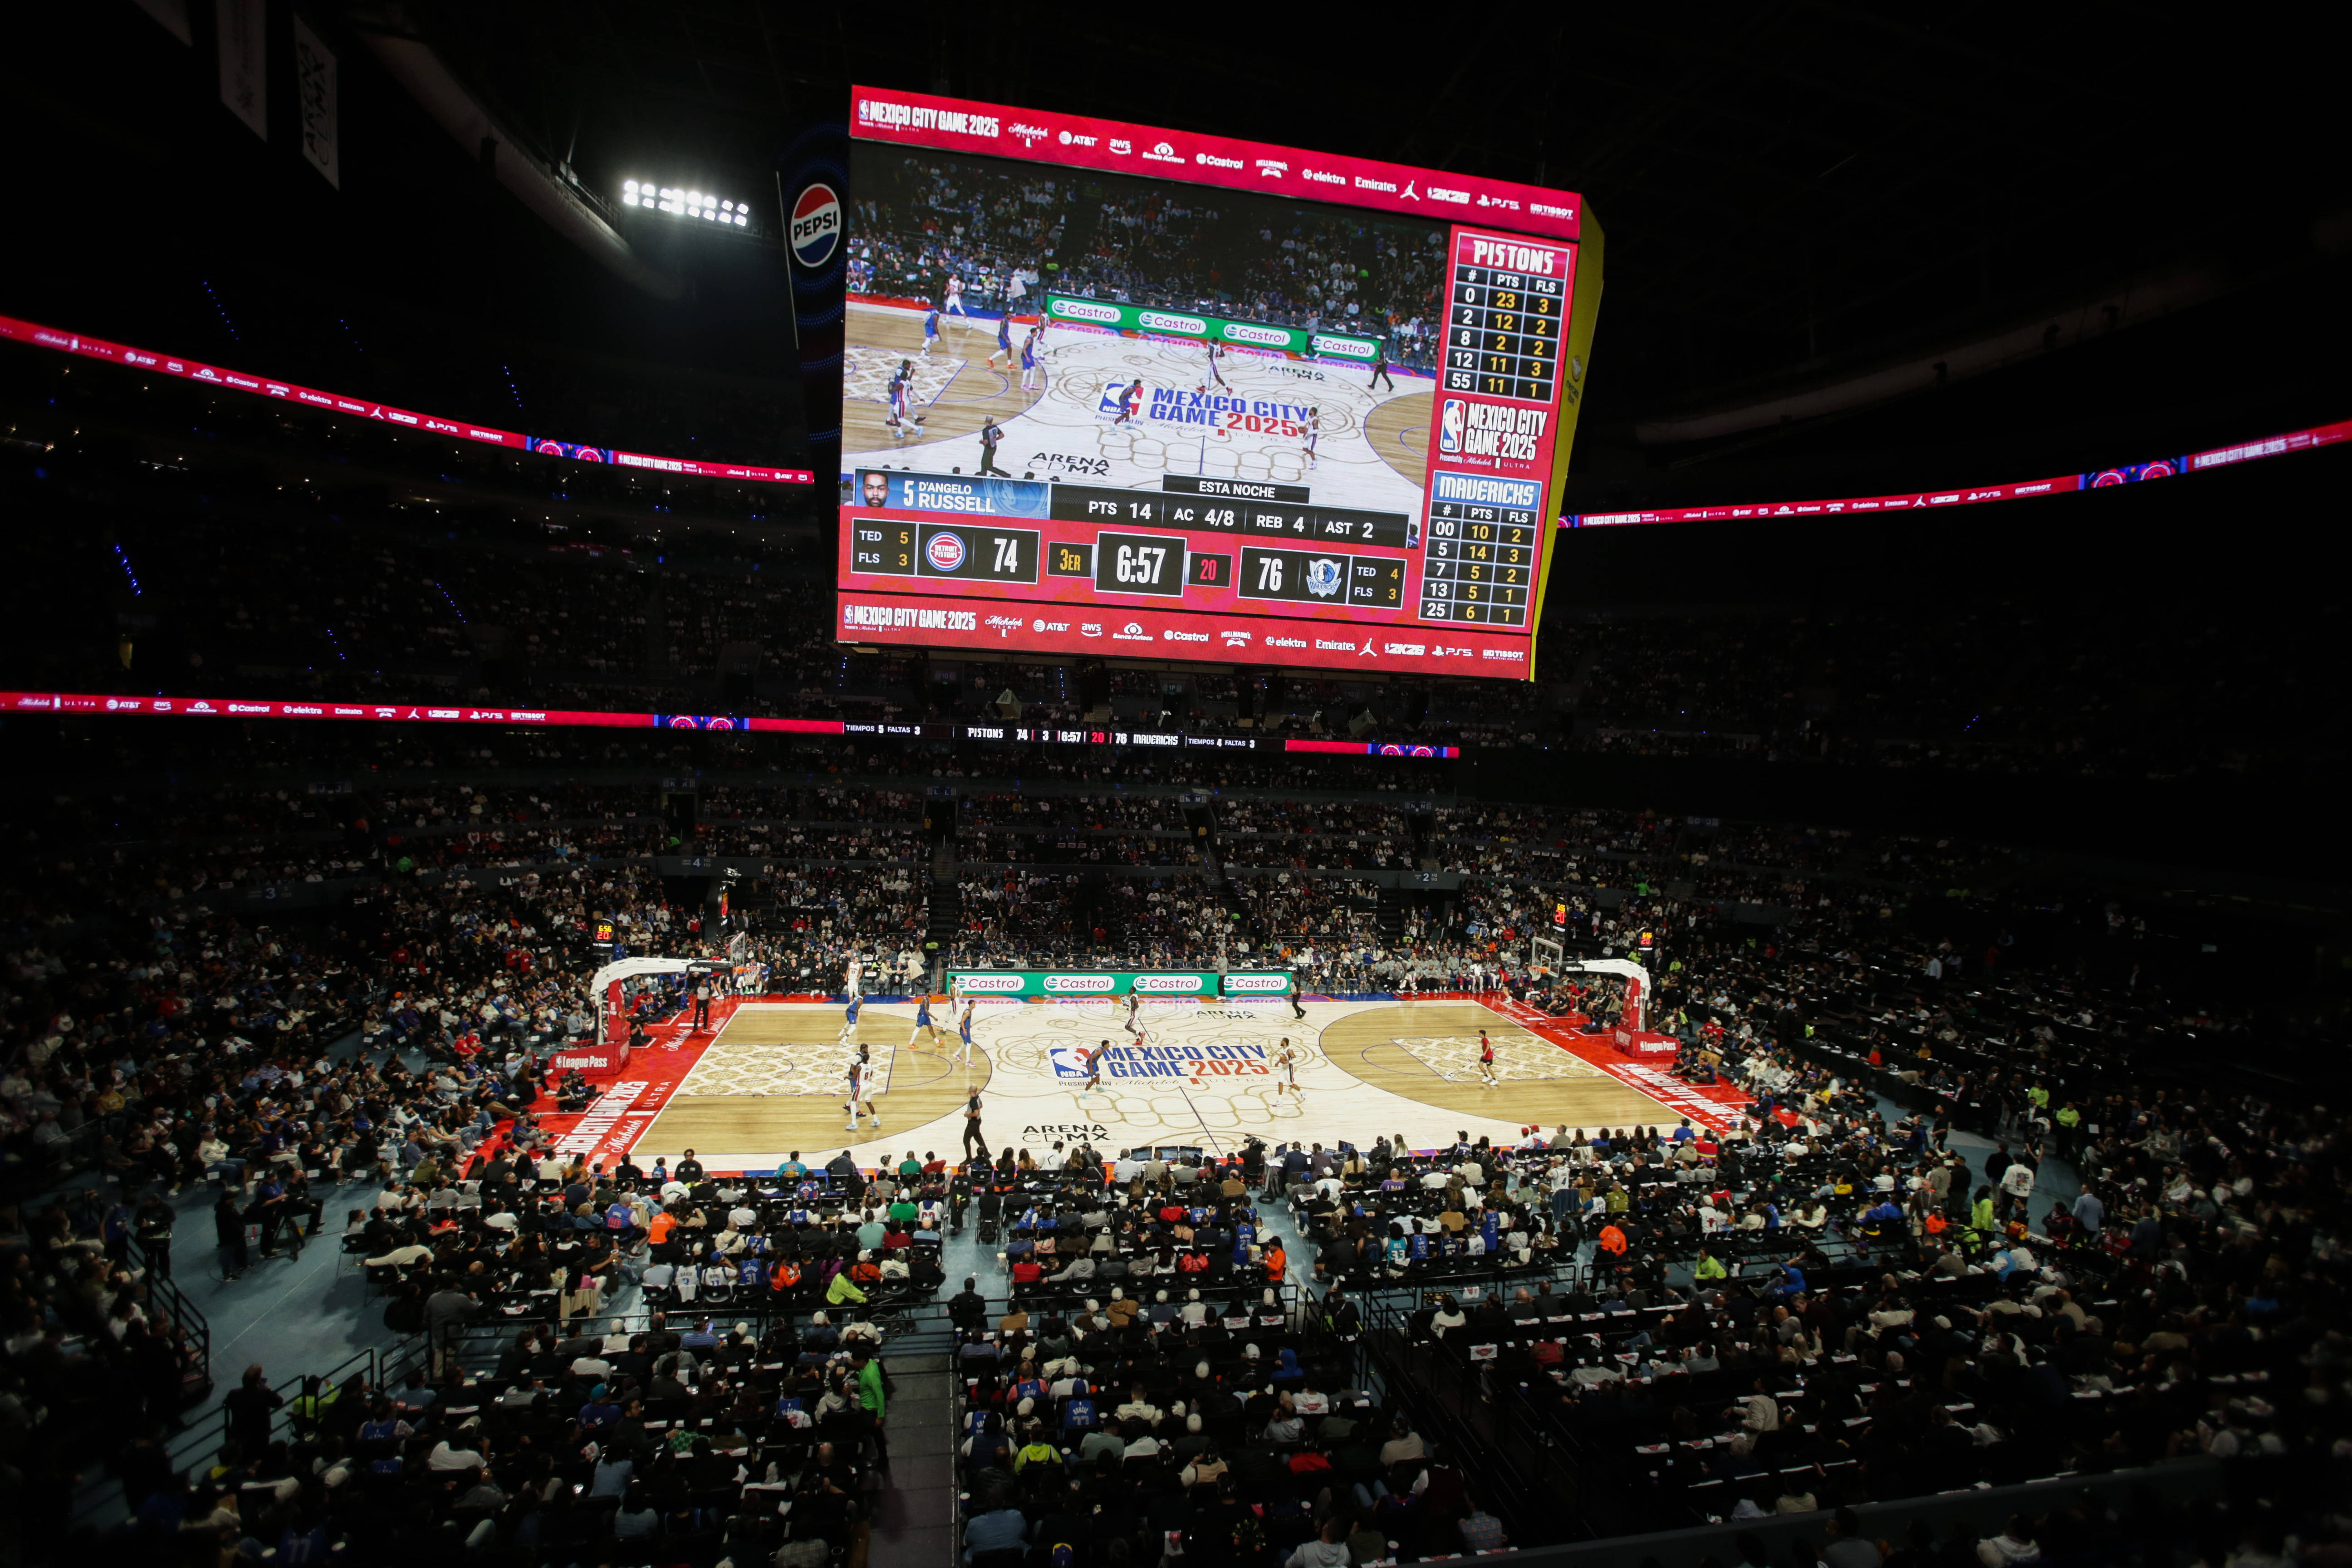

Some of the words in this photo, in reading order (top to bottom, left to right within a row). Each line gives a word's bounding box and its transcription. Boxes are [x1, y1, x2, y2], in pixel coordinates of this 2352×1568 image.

[870, 101, 911, 125] MEXICO
[912, 107, 937, 129] CITY
[939, 111, 969, 133] GAME
[969, 115, 999, 137] 2025
[1008, 123, 1048, 137] Michelob
[1073, 135, 1098, 146] AT&T
[1110, 138, 1131, 148] aws
[1142, 152, 1162, 161] Banco
[1206, 155, 1244, 169] Castrol
[1313, 171, 1346, 185] elektra
[1355, 176, 1397, 193] Emirates
[1432, 187, 1470, 204] 2K26
[1492, 198, 1520, 210] PS5
[1543, 205, 1573, 217] TISSOT
[794, 210, 837, 240] PEPSI
[1474, 240, 1555, 274] PISTONS
[1497, 274, 1519, 288] PTS
[1536, 280, 1556, 293] FLS
[1465, 288, 1475, 303] 0
[1496, 292, 1515, 309] 23
[1539, 298, 1548, 313] 3
[1068, 305, 1116, 319] Castrol
[1155, 317, 1201, 331] Castrol
[1239, 329, 1285, 343] Castrol
[1323, 340, 1370, 354] Castrol
[137, 356, 157, 365] AT&T
[1455, 352, 1473, 368] 12
[1491, 357, 1506, 372] 11
[1531, 362, 1541, 377] 3
[234, 378, 258, 387] Castrol
[1452, 373, 1471, 389] 55
[1488, 377, 1504, 393] 11
[1530, 383, 1537, 397] 1
[308, 395, 332, 404] elektra
[339, 401, 364, 412] Emirates
[1153, 388, 1247, 413] MEXICO
[1254, 401, 1308, 421] CITY
[1150, 403, 1221, 427] GAME
[1227, 412, 1298, 437] 2025
[1467, 403, 1516, 432] MEXICO
[1517, 409, 1547, 436] CITY
[1465, 428, 1501, 456] GAME
[1501, 432, 1537, 461] 2025
[1031, 452, 1110, 468] ARENA
[1440, 453, 1458, 463] Presented
[1464, 456, 1491, 466] Michelob
[1028, 460, 1112, 477] CDMX
[903, 480, 914, 507] 5
[918, 482, 972, 495] D'ANGELO
[1199, 481, 1230, 494] ESTA
[1233, 484, 1275, 498] NOCHE
[1439, 476, 1534, 506] MAVERICKS
[918, 493, 996, 513] RUSSELL
[1088, 501, 1117, 515] PTS
[1129, 503, 1152, 520] 14
[1173, 508, 1194, 521] AC
[1205, 509, 1235, 527] 4/8
[1256, 514, 1283, 529] REB
[1293, 516, 1304, 532] 4
[1325, 521, 1353, 535] AST
[1362, 522, 1373, 539] 2
[1471, 508, 1493, 519] PTS
[1509, 511, 1529, 523] FLS
[859, 530, 882, 541] TED
[899, 532, 908, 544] 5
[1436, 521, 1454, 536] 00
[1471, 525, 1489, 539] 10
[1511, 529, 1521, 542] 2
[934, 544, 958, 553] DETROIT
[994, 538, 1018, 573] 74
[1438, 542, 1448, 556] 5
[1470, 545, 1486, 559] 14
[1509, 549, 1519, 563] 3
[859, 552, 880, 564] FLS
[899, 554, 908, 566] 3
[1060, 549, 1081, 571] 3ER
[1117, 545, 1166, 584] 6:57
[1200, 559, 1217, 581] 20
[1258, 557, 1283, 592] 76
[1357, 566, 1376, 577] TED
[1390, 568, 1399, 580] 4
[1354, 587, 1373, 598] FLS
[1389, 588, 1396, 600] 3
[854, 605, 893, 626] MEXICO
[894, 608, 918, 627] CITY
[919, 609, 948, 628] GAME
[948, 611, 977, 631] 2025
[1426, 603, 1446, 617] 25
[1466, 606, 1475, 619] 6
[1504, 609, 1510, 622] 1
[1174, 631, 1209, 642] Castrol
[1275, 637, 1307, 648] elektra
[1316, 639, 1356, 651] Emirates
[293, 706, 322, 715] elektra
[878, 725, 884, 734] 5
[915, 726, 921, 735] 3
[968, 727, 1003, 739] PISTONS
[1017, 729, 1028, 740] 74
[1043, 730, 1049, 741] 3
[1061, 731, 1081, 742] 6:57
[1092, 731, 1105, 743] 20
[1115, 733, 1127, 744] 76
[1133, 734, 1178, 746] MAVERICKS
[1216, 738, 1222, 747] 4
[1250, 740, 1255, 748] 3
[693, 858, 701, 867] 4
[597, 931, 610, 940] 20
[969, 979, 1019, 988] Castrol
[1060, 979, 1109, 988] Castrol
[1149, 979, 1197, 988] Castrol
[1235, 979, 1282, 988] Castrol
[1102, 1046, 1205, 1061] MEXICO
[1205, 1045, 1267, 1059] CITY
[1644, 1041, 1662, 1052] League
[1663, 1040, 1676, 1051] Pass
[562, 1056, 588, 1069] League
[589, 1055, 608, 1068] Pass
[1107, 1061, 1189, 1078] GAME
[1189, 1059, 1270, 1076] 2025
[606, 1081, 649, 1098] 2025
[587, 1098, 635, 1117] GAME
[604, 1119, 644, 1153] Michelob
[642, 1081, 671, 1107] ULTRA
[571, 1117, 617, 1134] CITY
[1023, 1124, 1108, 1133] ARENA
[1022, 1133, 1111, 1142] CDMX
[1490, 1223, 1495, 1233] 3
[745, 1273, 756, 1284] 31
[1073, 1416, 1089, 1425] 77
